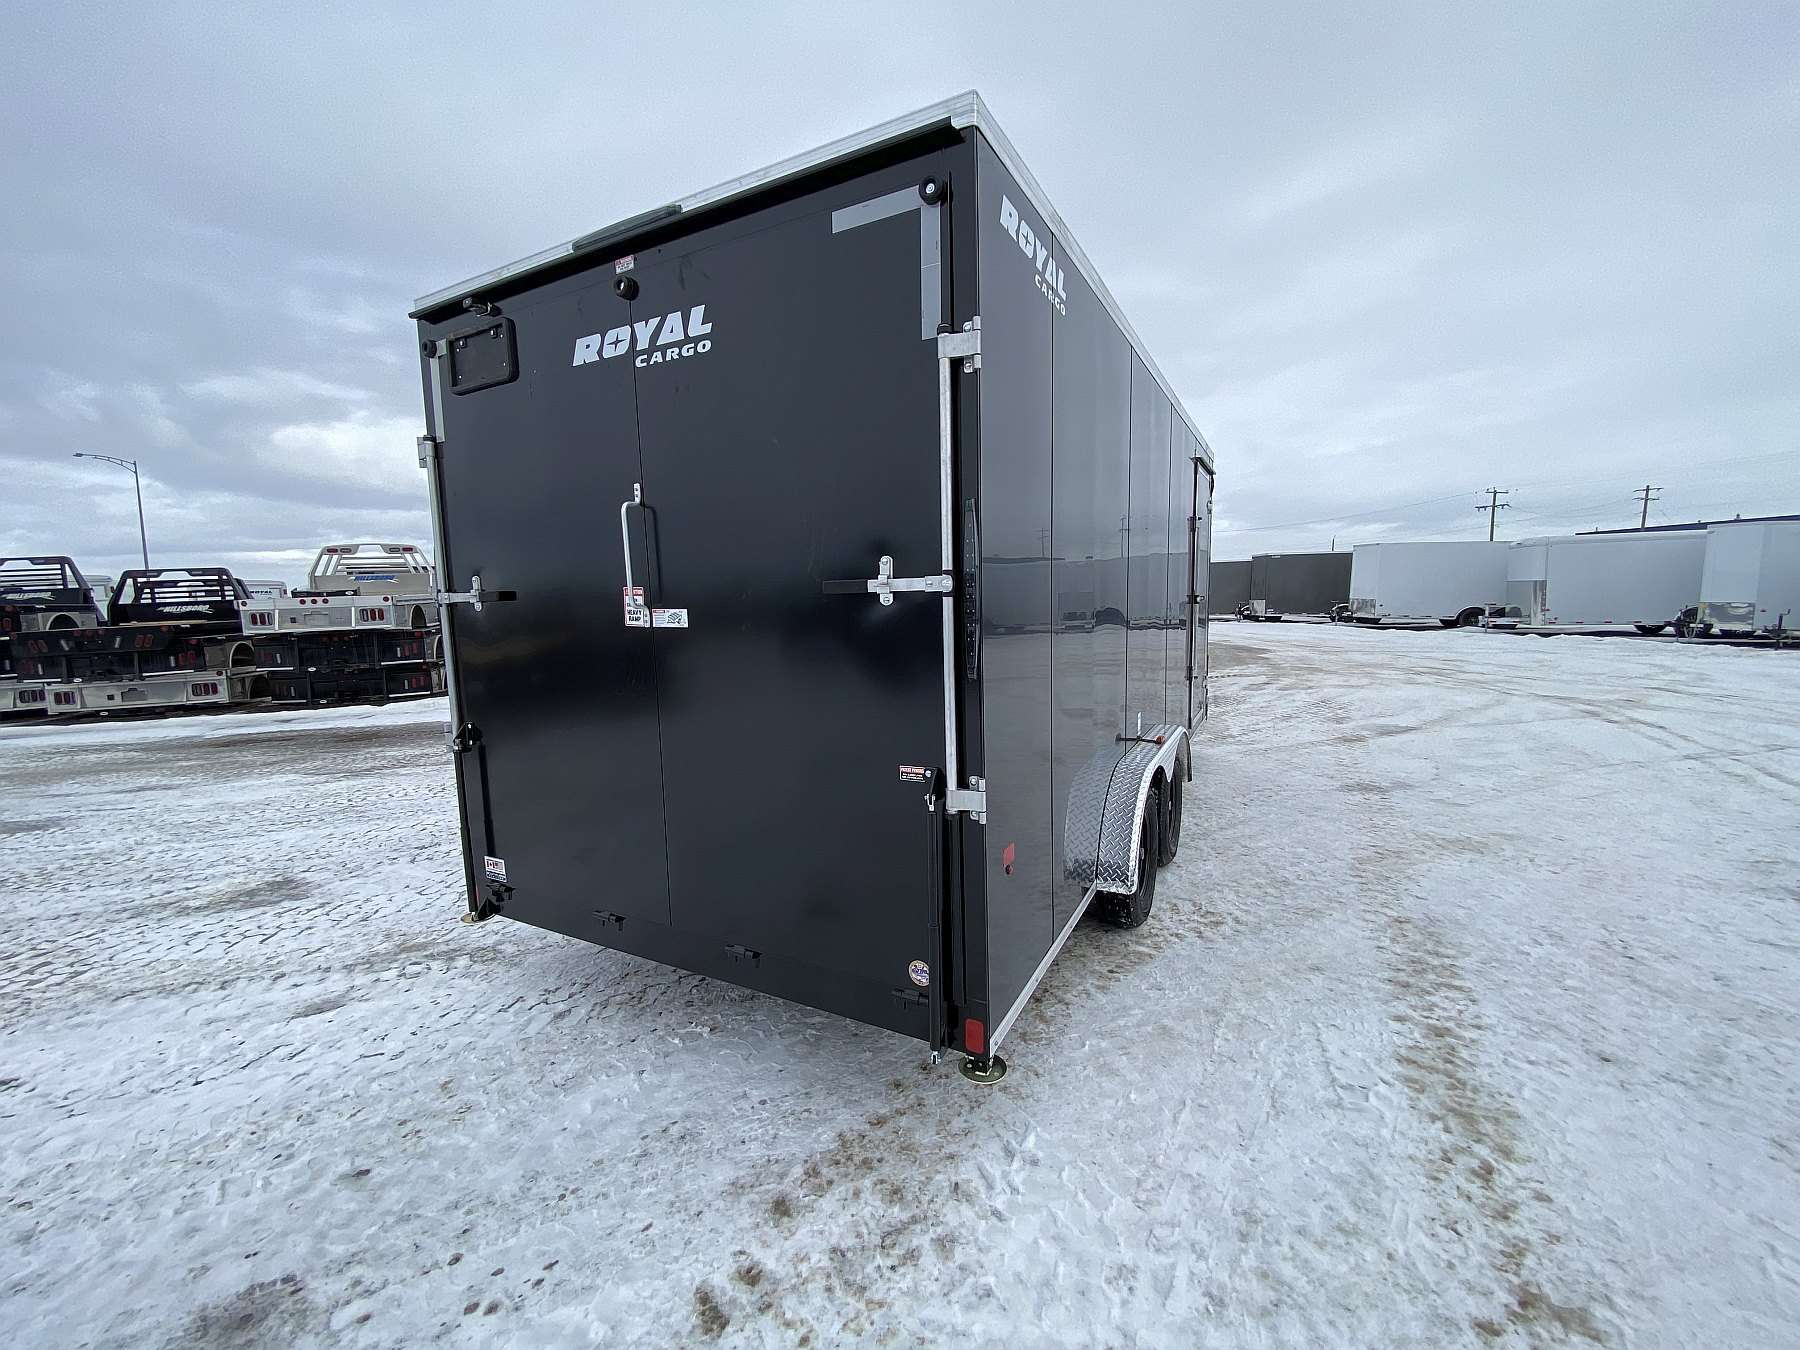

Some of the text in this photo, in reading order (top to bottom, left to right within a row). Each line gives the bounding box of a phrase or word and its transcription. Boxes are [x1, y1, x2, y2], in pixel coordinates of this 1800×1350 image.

[1000, 194, 1067, 301] ROYAL
[1034, 273, 1067, 316] CARGO
[572, 304, 713, 366] ROYAL
[635, 340, 711, 368] CARGO
[163, 604, 210, 613] HILLSBORO
